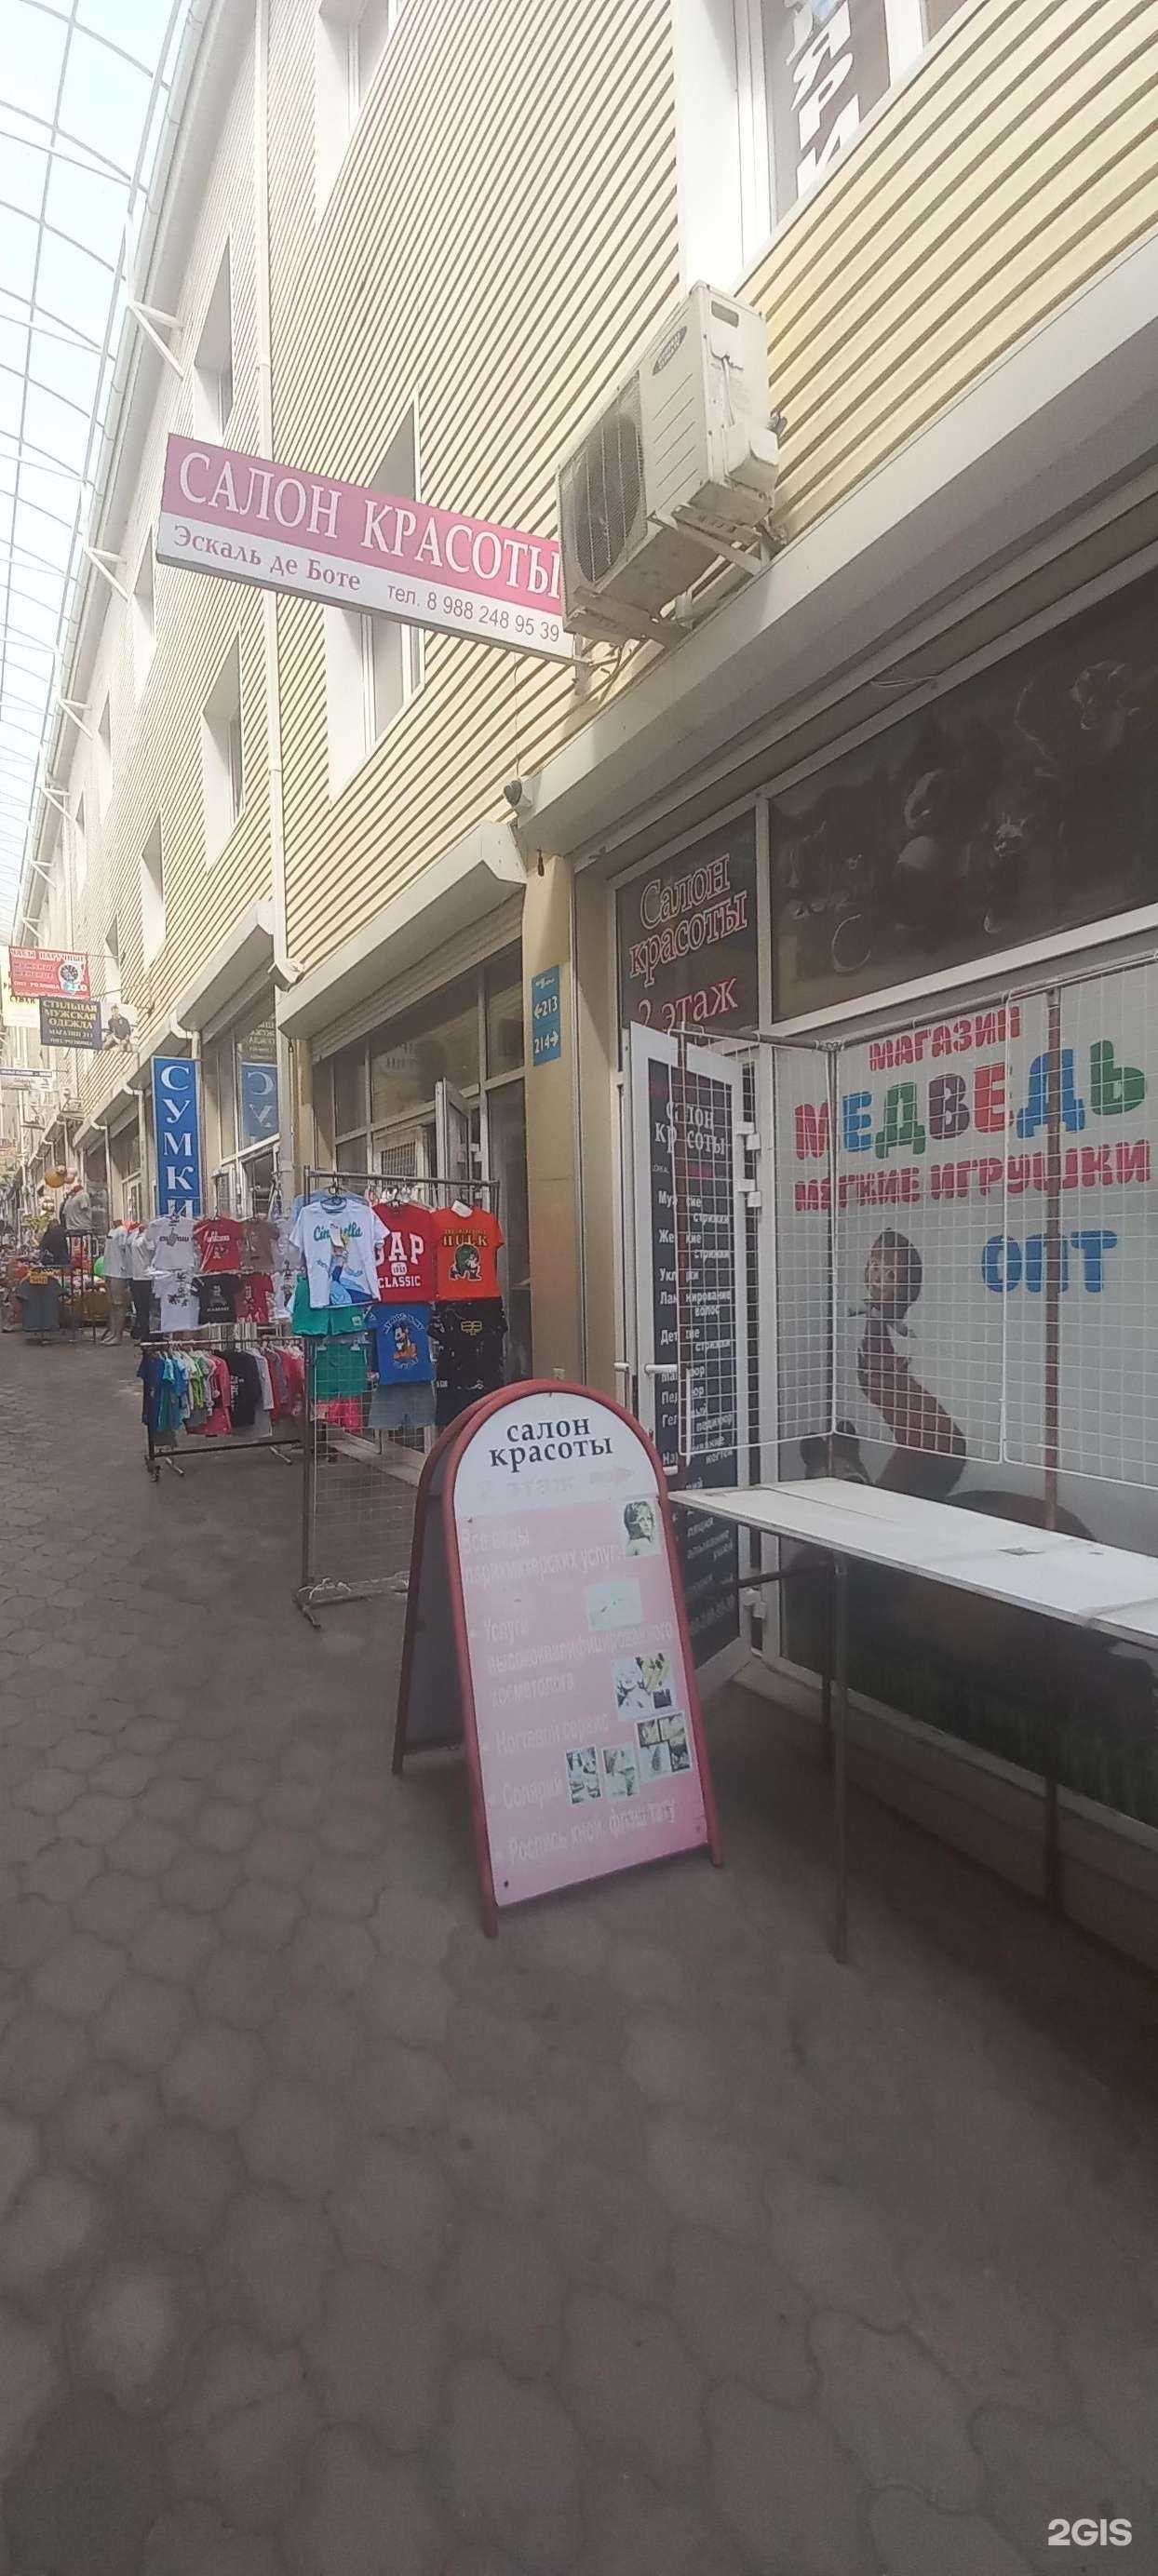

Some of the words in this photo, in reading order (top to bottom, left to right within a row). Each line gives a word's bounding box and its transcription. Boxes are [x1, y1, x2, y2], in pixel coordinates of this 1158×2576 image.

[179, 451, 343, 540] САЛОН
[360, 498, 562, 600] КРАСОТЫ
[173, 524, 263, 567] Эскаль
[269, 553, 299, 576] де
[306, 558, 362, 592] Боте
[386, 584, 421, 609] тел.
[426, 592, 438, 610] 8
[442, 595, 474, 621] 988
[478, 604, 510, 629] 248
[514, 614, 535, 637] 95
[539, 621, 560, 643] 39
[640, 852, 731, 930] Салон
[628, 890, 748, 989] красоты
[541, 995, 558, 1017] 213
[660, 977, 739, 1033] этаж
[534, 1033, 550, 1054] 214
[868, 1005, 1021, 1072] МАГАЗИН
[794, 1039, 1148, 1161] МЕДВЕДЬ
[160, 1065, 194, 1218] СУМКИ
[654, 1121, 725, 1155] крсоты
[794, 1166, 921, 1212] МЯГКИЕ
[930, 1138, 1151, 1201] ИГРУШКИ
[378, 1275, 422, 1289] CLASSIC
[981, 1228, 1118, 1294] ОПТ
[488, 1437, 614, 1474] красоты
[505, 1417, 591, 1443] салон
